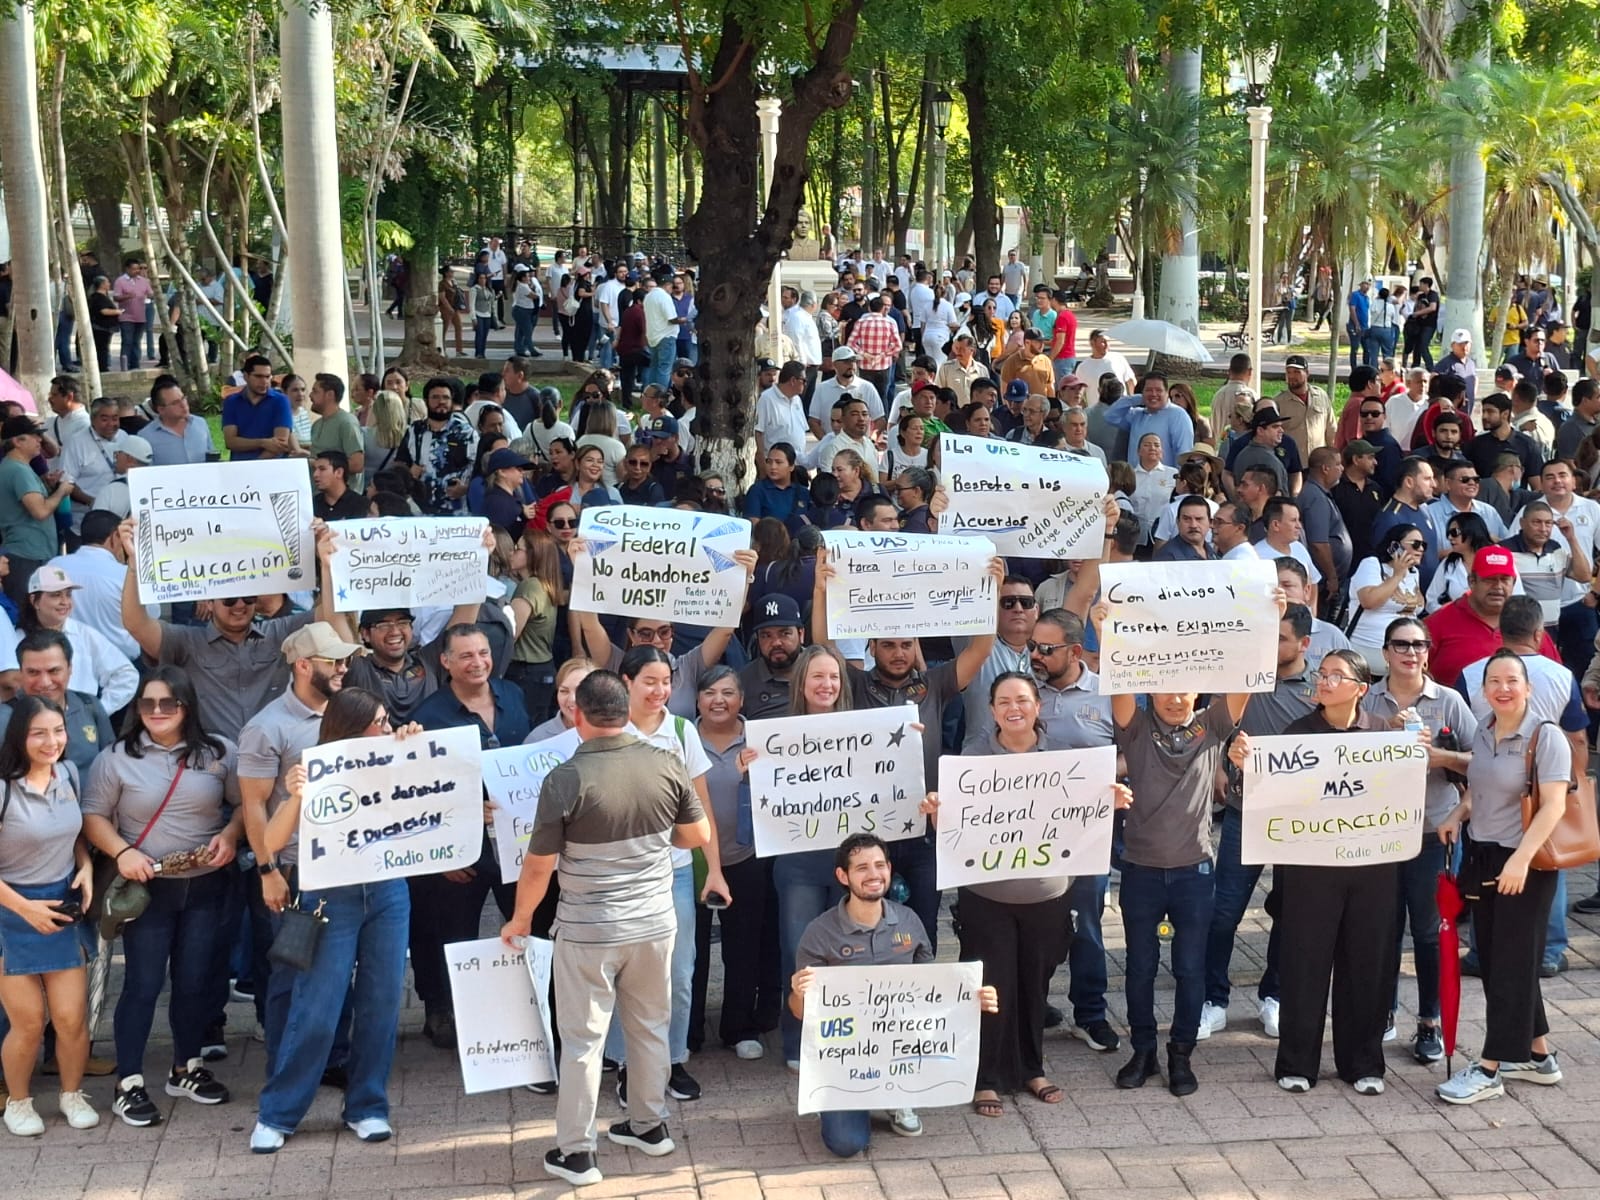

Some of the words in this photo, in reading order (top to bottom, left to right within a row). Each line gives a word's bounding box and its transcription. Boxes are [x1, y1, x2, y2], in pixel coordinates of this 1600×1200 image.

[986, 444, 1021, 456] UAS
[1039, 478, 1061, 491] los
[151, 485, 261, 509] Federación
[594, 510, 681, 531] Gobierno
[1037, 528, 1061, 549] exige
[1063, 499, 1094, 526] respeto
[155, 524, 194, 546] Apoya
[208, 521, 222, 535] la
[361, 523, 391, 541] UAS
[398, 530, 408, 544] y
[415, 525, 427, 539] la
[621, 532, 696, 557] Federal
[870, 537, 907, 548] UAS
[159, 551, 284, 582] Educación
[349, 549, 421, 567] Sinaloense
[592, 558, 613, 577] No
[621, 562, 711, 583] abandones
[152, 583, 179, 593] Radio
[592, 583, 604, 601] la
[686, 587, 705, 596] Radio
[1108, 582, 1144, 604] Con
[1245, 671, 1275, 688] UAS
[766, 732, 872, 756] Gobierno
[1335, 744, 1425, 765] RECURSOS
[308, 752, 394, 782] Defender
[407, 752, 416, 760] a
[496, 760, 519, 777] La
[527, 752, 561, 772] UAS
[774, 757, 852, 787] Federal
[875, 759, 895, 774] no
[959, 769, 1061, 796] Gobierno
[1324, 772, 1364, 796] MÁS
[311, 791, 352, 819] UAS
[361, 792, 381, 806] es
[391, 781, 456, 800] defender
[772, 792, 861, 817] abandones
[871, 795, 879, 804] a
[893, 784, 906, 801] la
[961, 800, 1035, 829] Federal
[1051, 799, 1110, 828] cumple
[990, 830, 1023, 845] con
[1042, 823, 1058, 840] la
[384, 850, 424, 869] Radio
[430, 845, 454, 859] UAS
[982, 843, 1051, 871] UAS
[1335, 846, 1371, 860] Radio
[822, 985, 851, 1008] Los
[868, 984, 914, 1019] logros
[925, 986, 942, 1003] de
[957, 982, 971, 1003] la
[820, 1017, 854, 1038] UAS
[872, 1017, 946, 1033] merecen
[819, 1039, 879, 1064] respaldo
[893, 1033, 955, 1062] Federal
[849, 1068, 881, 1080] Radio
